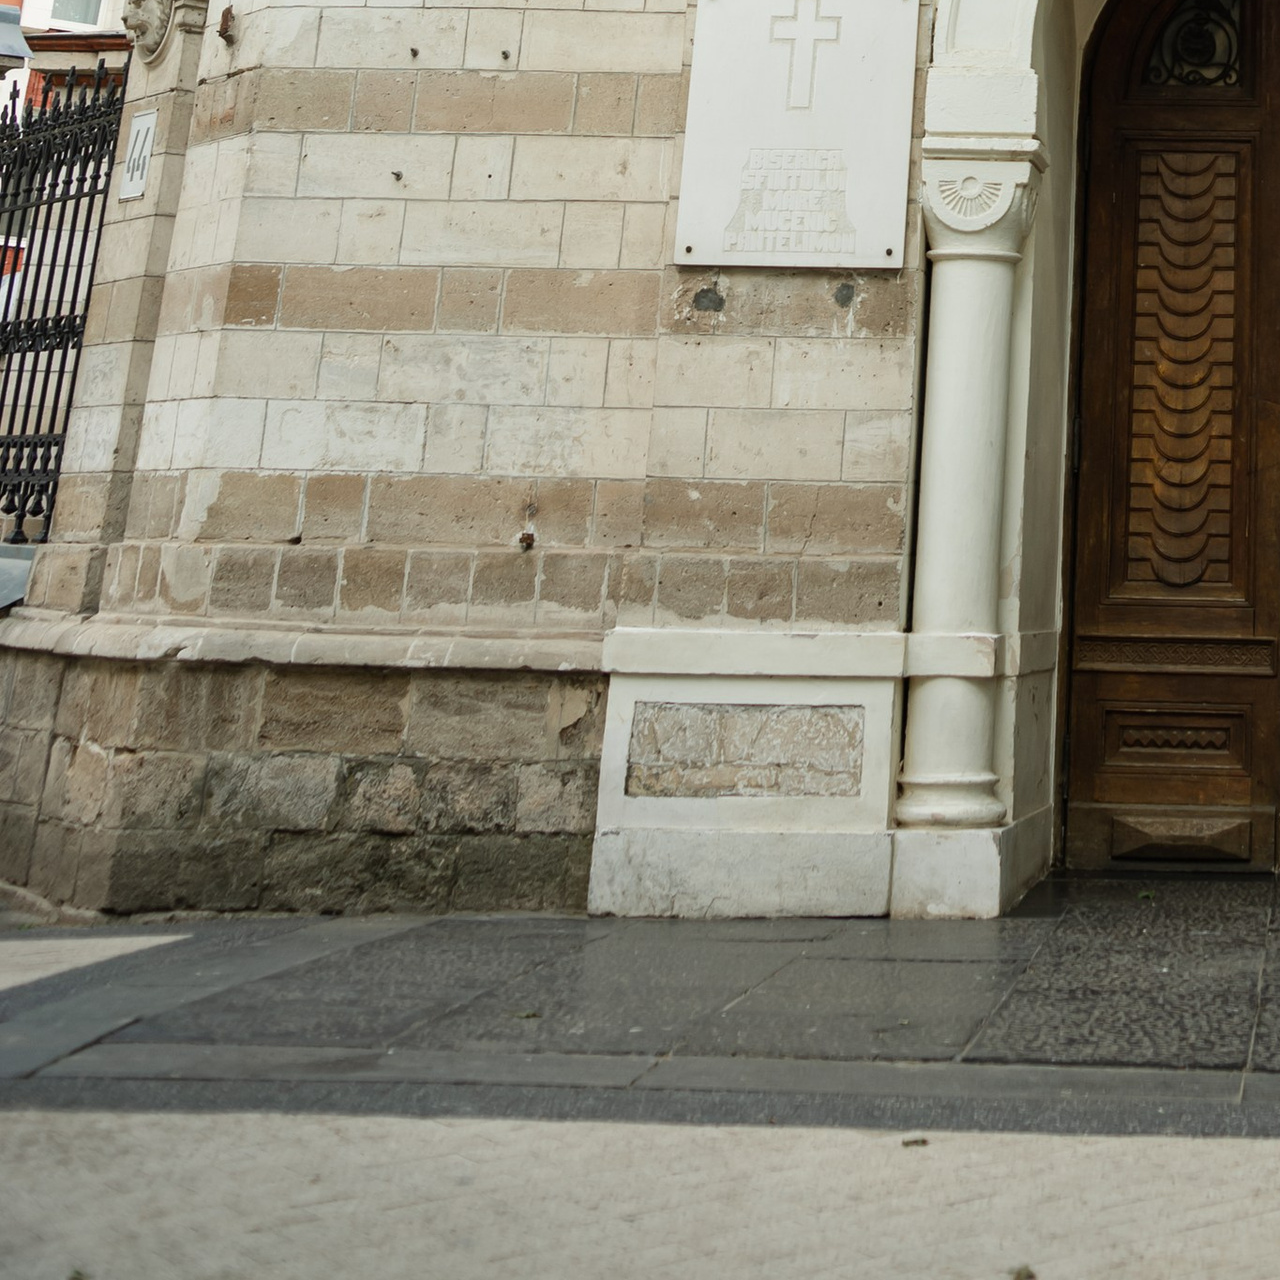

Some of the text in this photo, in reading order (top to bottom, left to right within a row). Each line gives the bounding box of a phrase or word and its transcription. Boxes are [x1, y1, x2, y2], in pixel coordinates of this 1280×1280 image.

[126, 126, 150, 182] 44
[749, 150, 841, 170] BISERICA
[763, 190, 823, 211] MARE
[744, 210, 839, 232] MUCENIC
[724, 231, 855, 253] PANTELIMON
